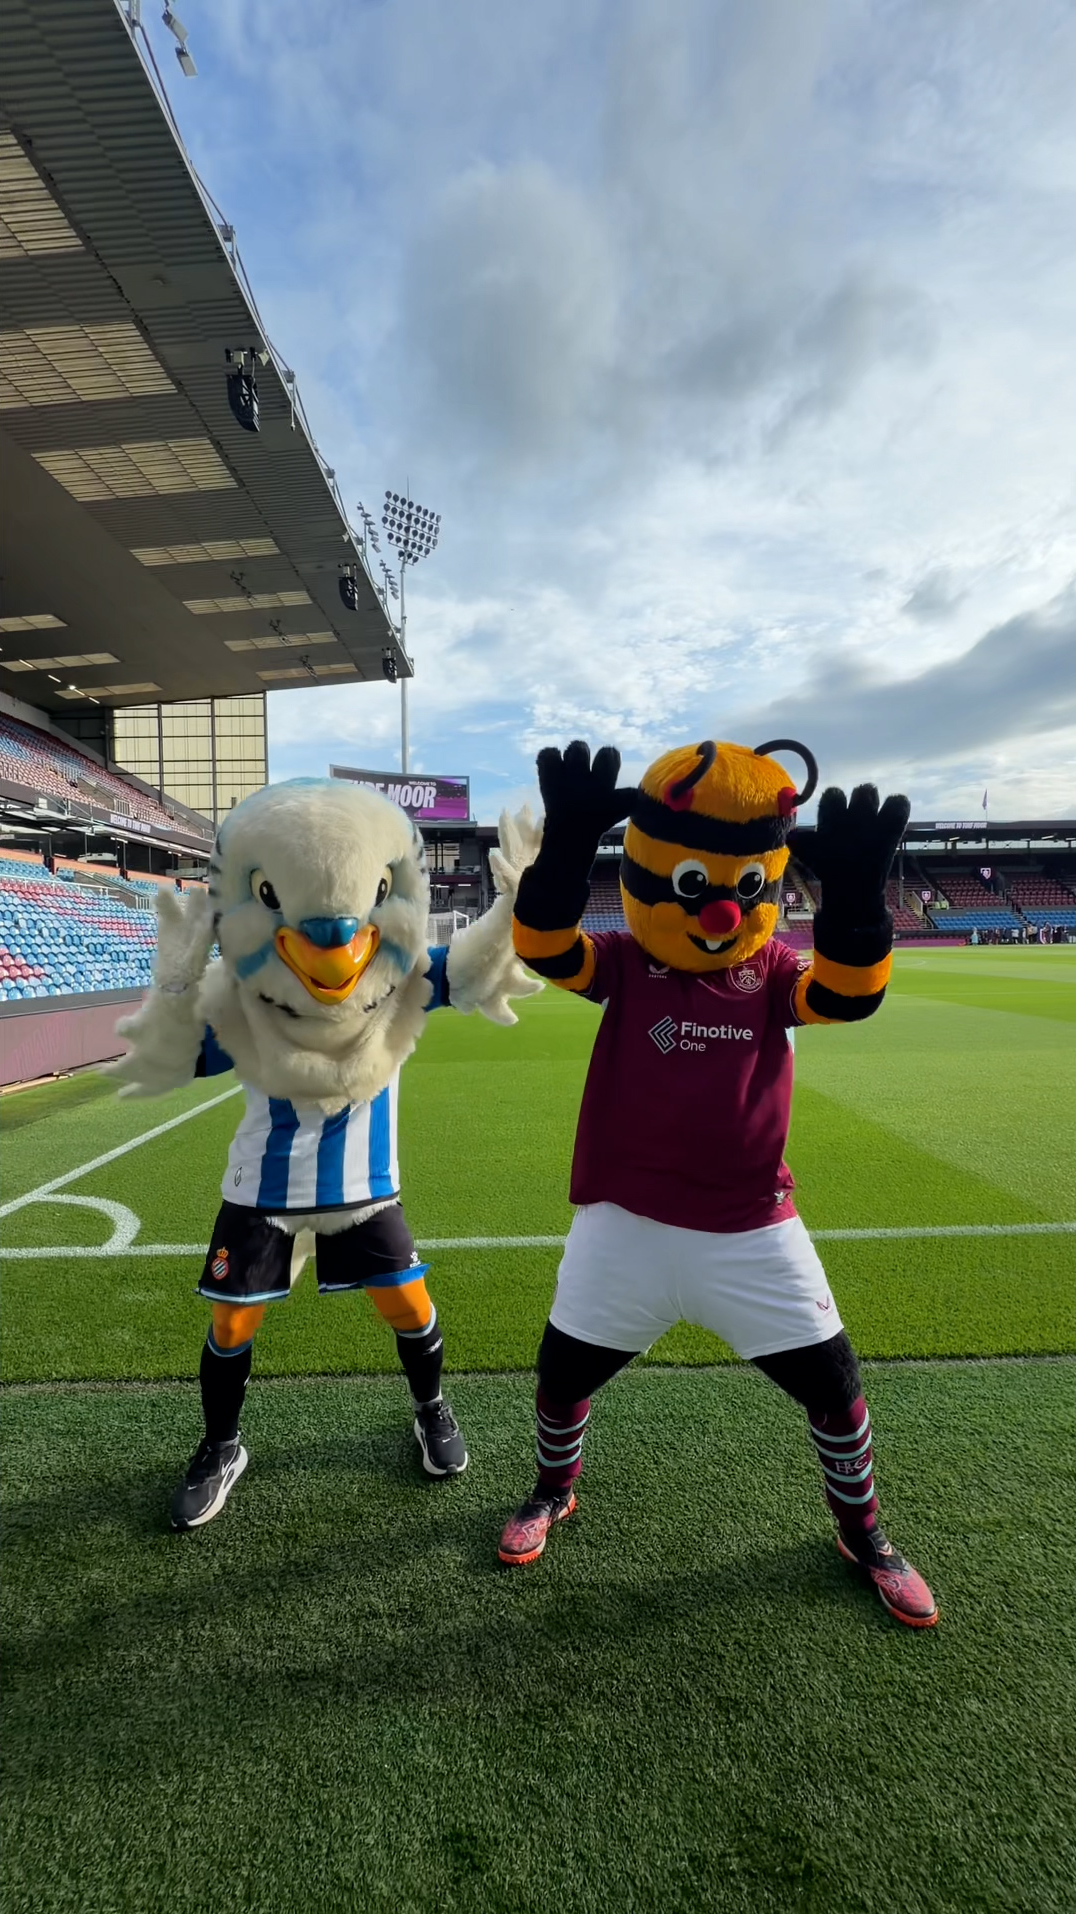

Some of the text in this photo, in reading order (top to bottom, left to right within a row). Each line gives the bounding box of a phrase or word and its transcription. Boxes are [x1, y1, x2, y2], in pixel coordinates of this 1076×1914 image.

[388, 784, 437, 808] MOOR
[681, 1022, 753, 1040] Finotive
[680, 1040, 706, 1051] One
